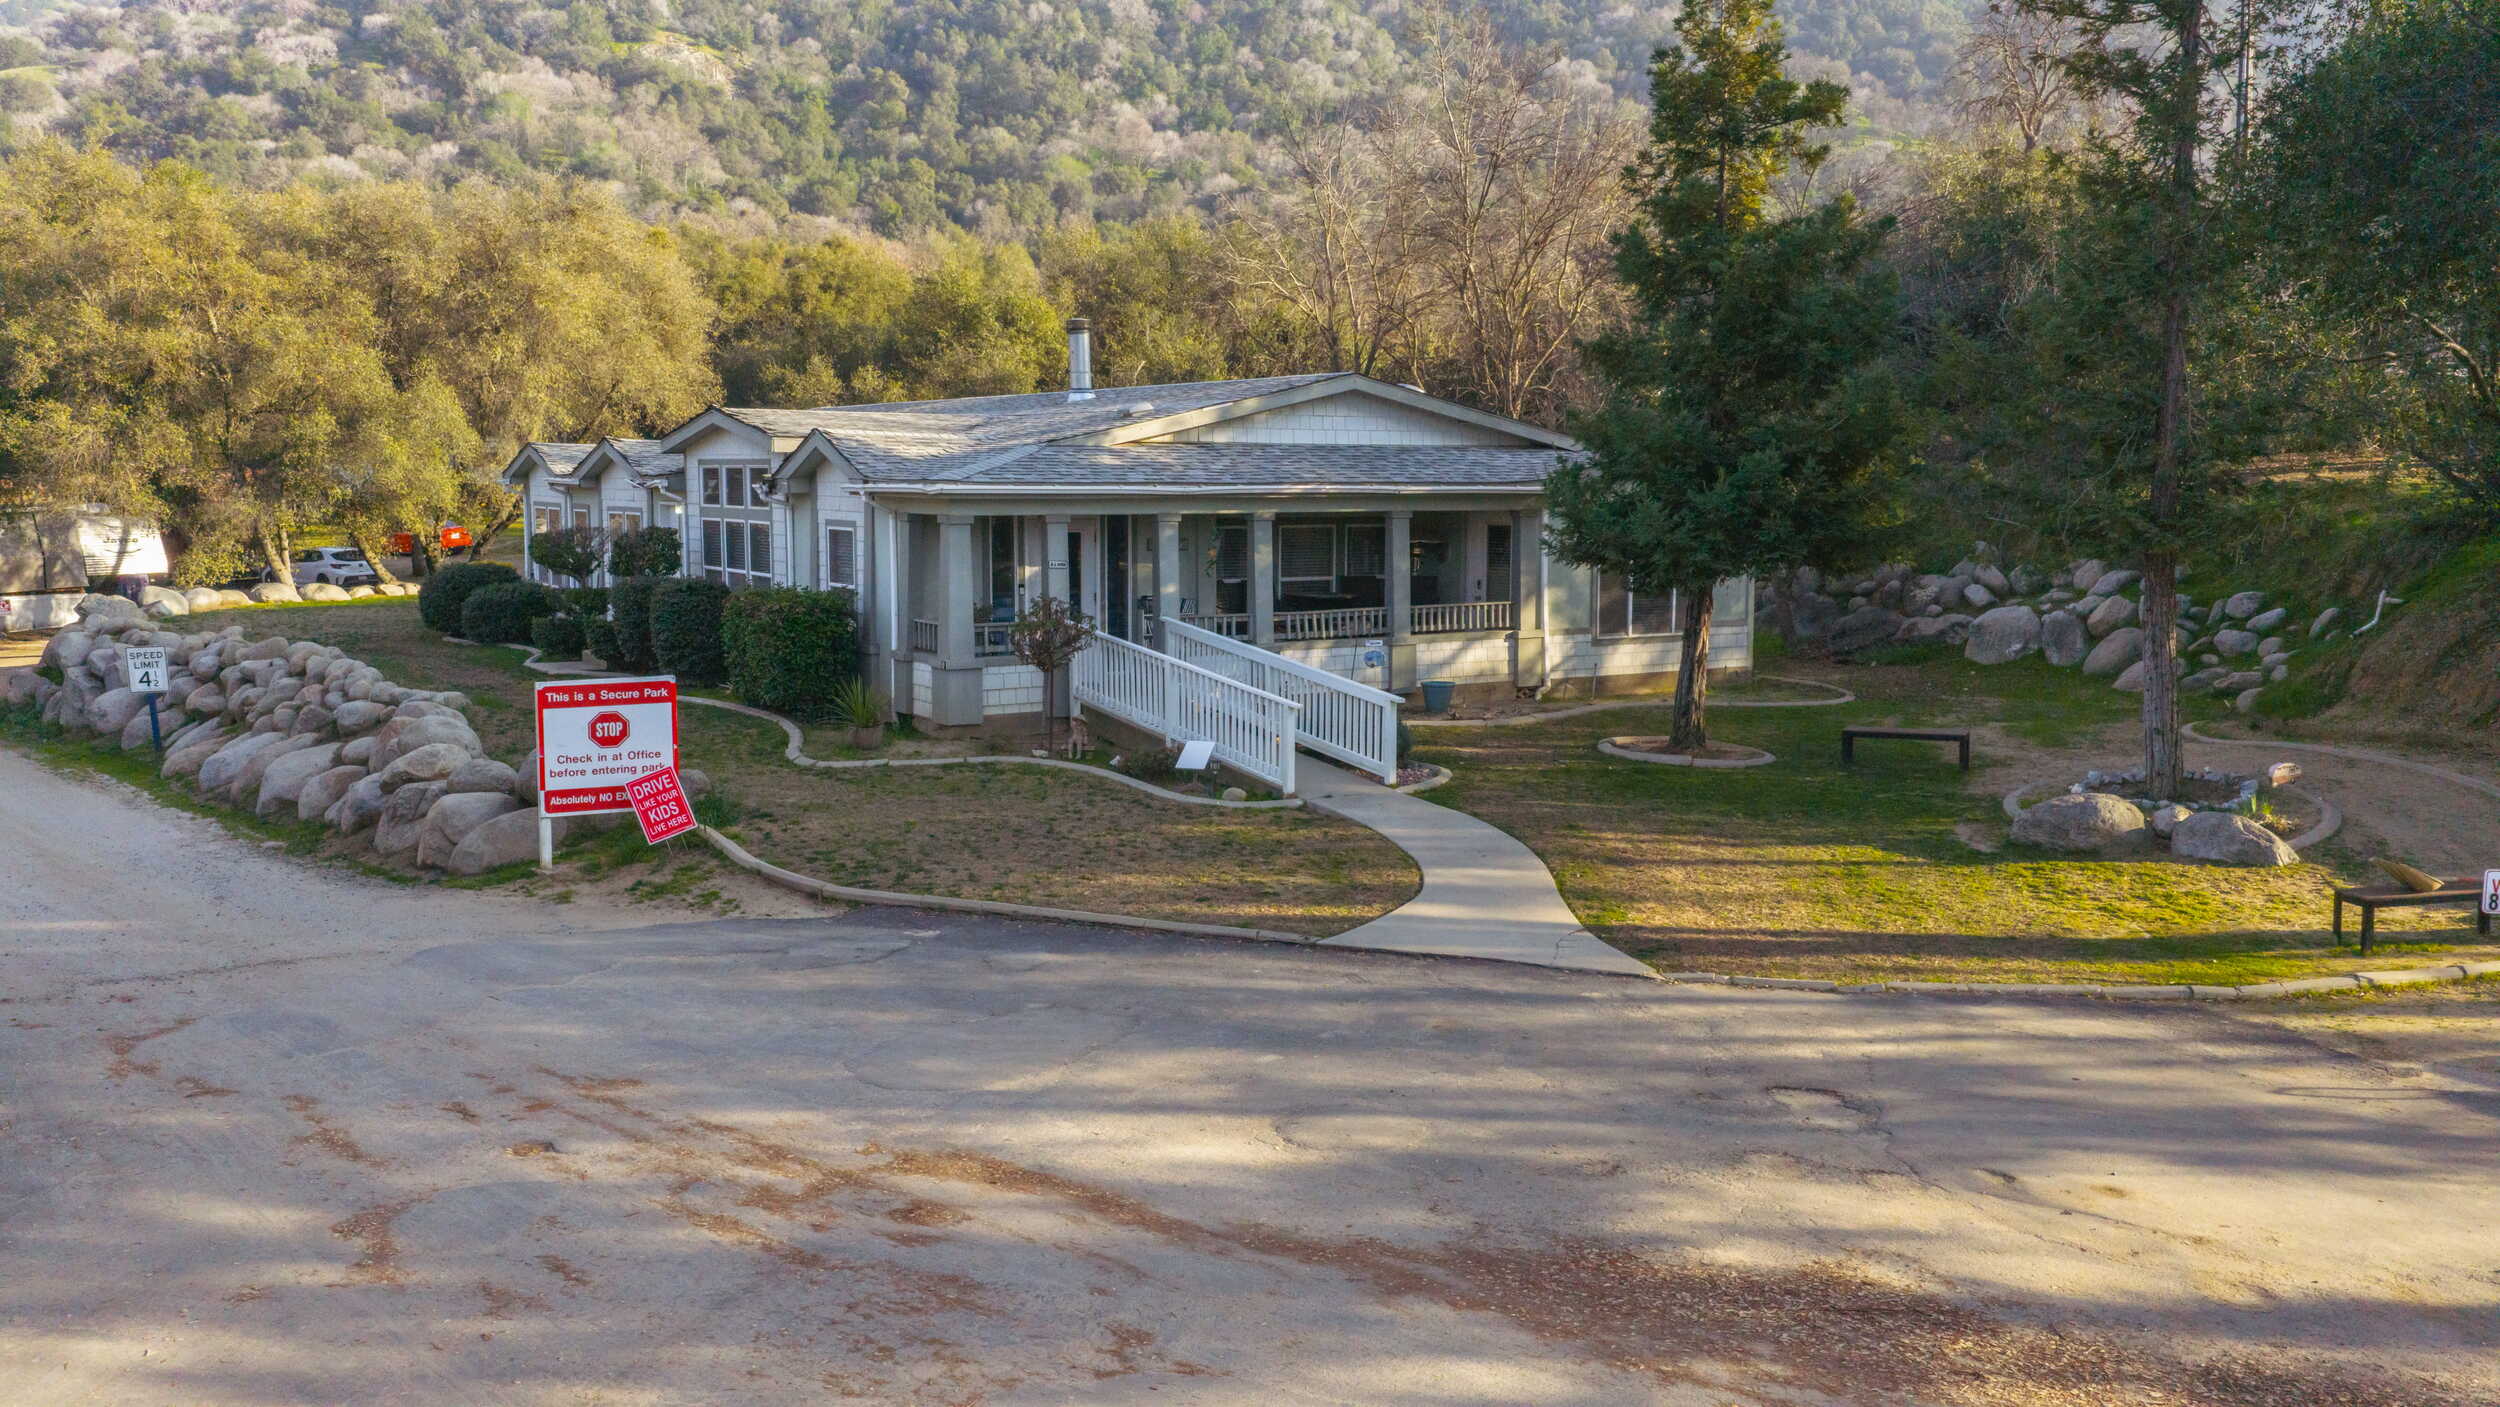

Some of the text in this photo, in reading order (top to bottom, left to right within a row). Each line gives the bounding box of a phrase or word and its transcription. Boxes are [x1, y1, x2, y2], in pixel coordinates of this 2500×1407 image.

[128, 651, 164, 660] SPEED
[134, 660, 160, 669] LIMIT
[545, 687, 669, 703] This is a Secure Park
[595, 721, 623, 738] STOP
[556, 749, 662, 765] Check in at Office
[549, 767, 586, 778] before
[592, 764, 637, 776] entering
[632, 774, 673, 800] DRIVE
[550, 794, 596, 806] Absolutely
[599, 792, 613, 801] NO
[639, 789, 678, 810] LIKE YOUR
[648, 801, 680, 823] KIDS
[650, 814, 689, 835] LIVE HERE
